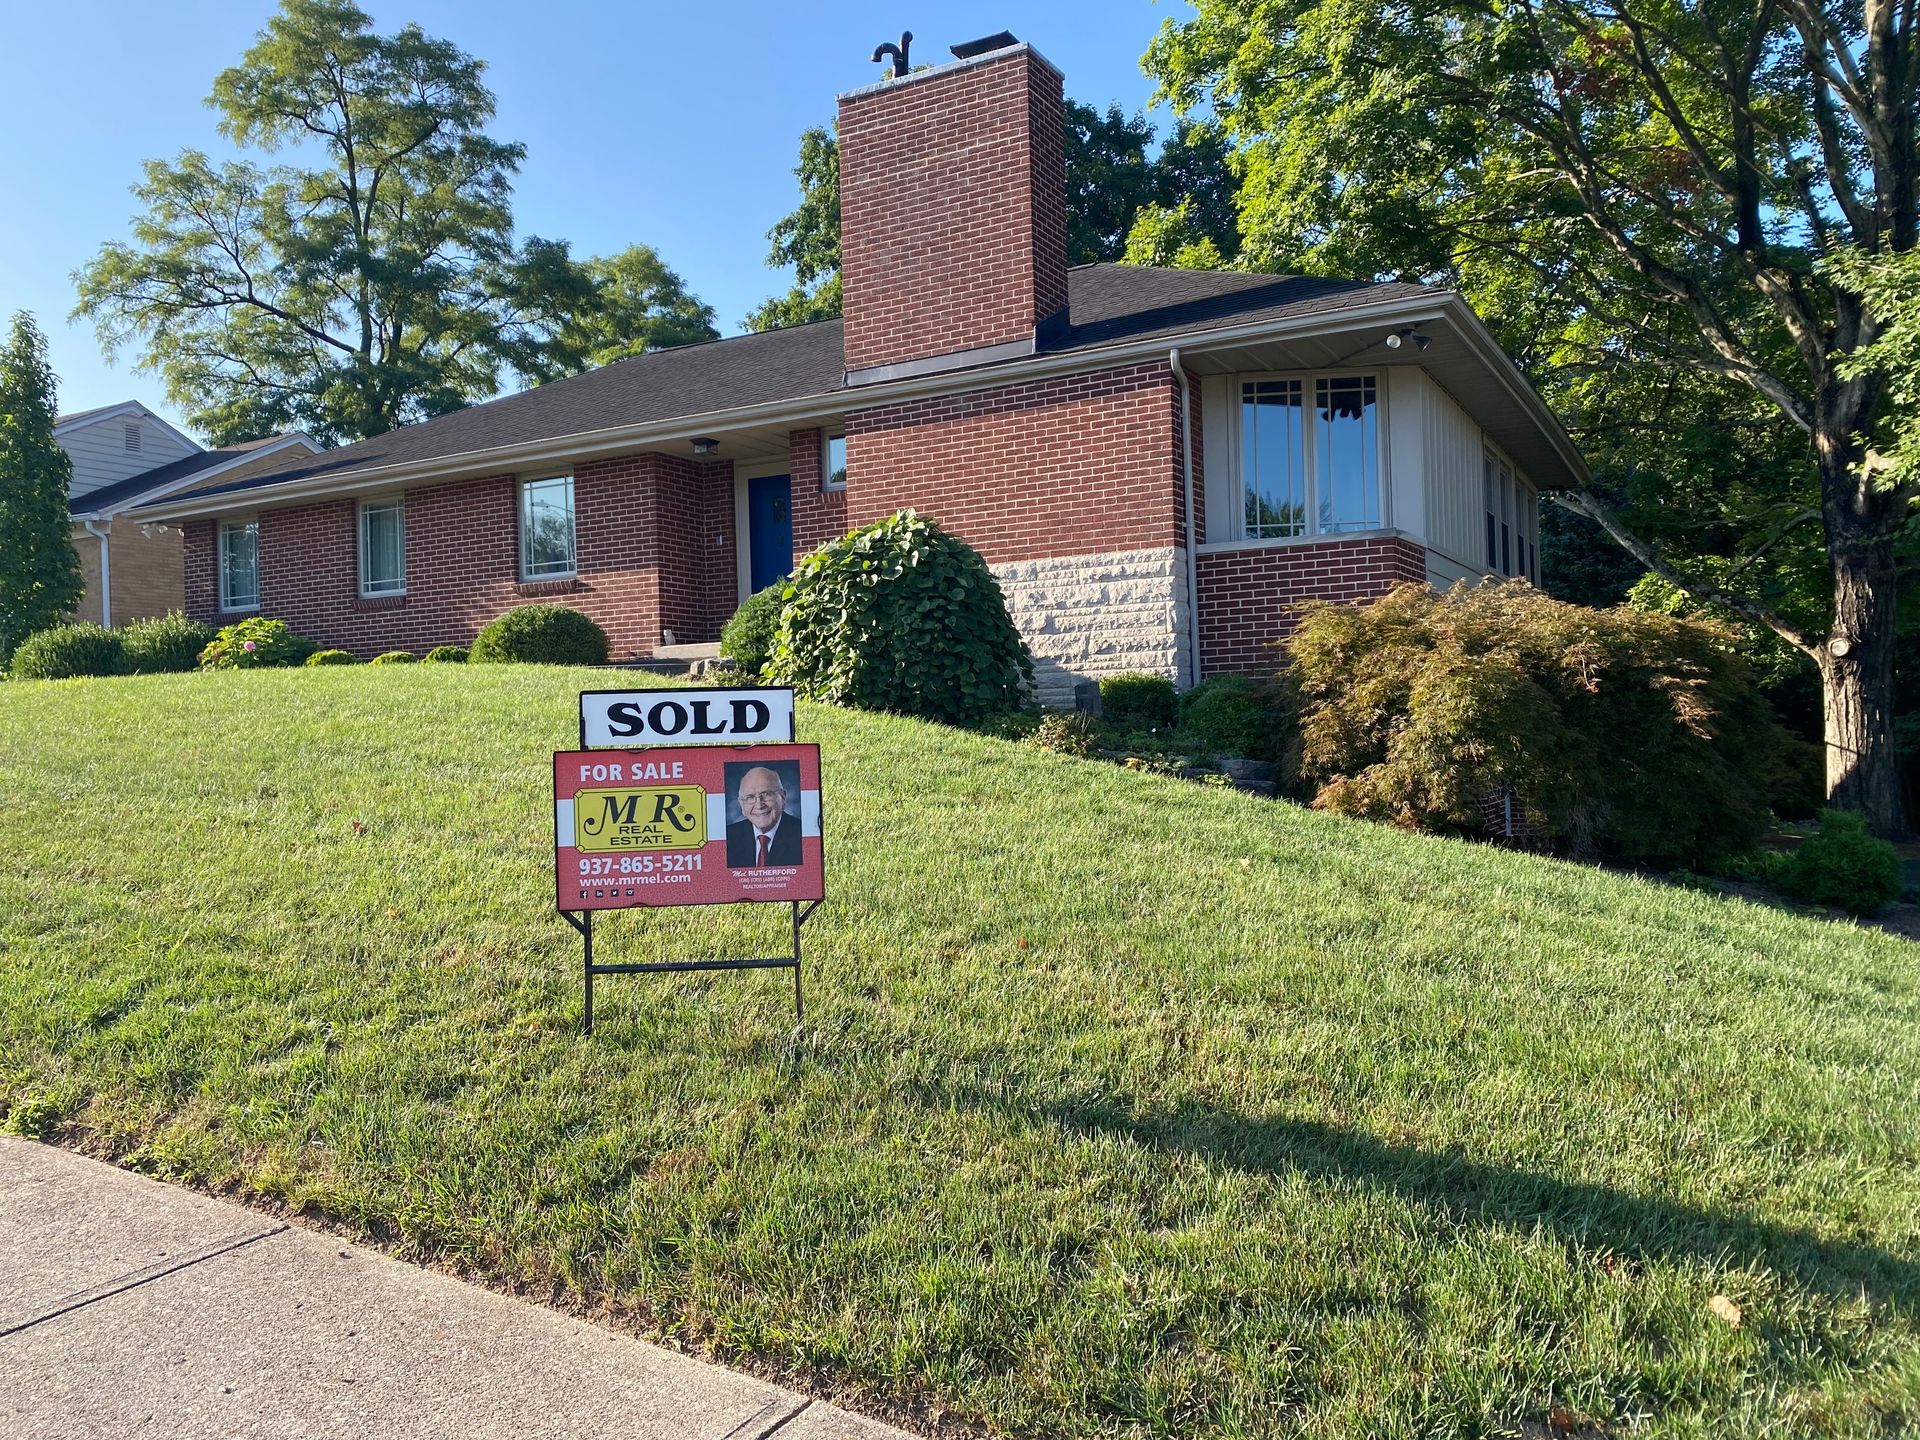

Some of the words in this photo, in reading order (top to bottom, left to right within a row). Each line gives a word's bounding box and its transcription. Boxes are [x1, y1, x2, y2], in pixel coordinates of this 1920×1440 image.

[607, 699, 770, 737] SOLD
[580, 764, 623, 782] FOR
[631, 762, 684, 780] SALE
[618, 824, 663, 835] REAL
[610, 834, 673, 846] ESTATE
[579, 854, 702, 876] 937-865-5211
[748, 868, 797, 877] RUTHERFORD
[579, 873, 691, 887] www.mrmel.com
